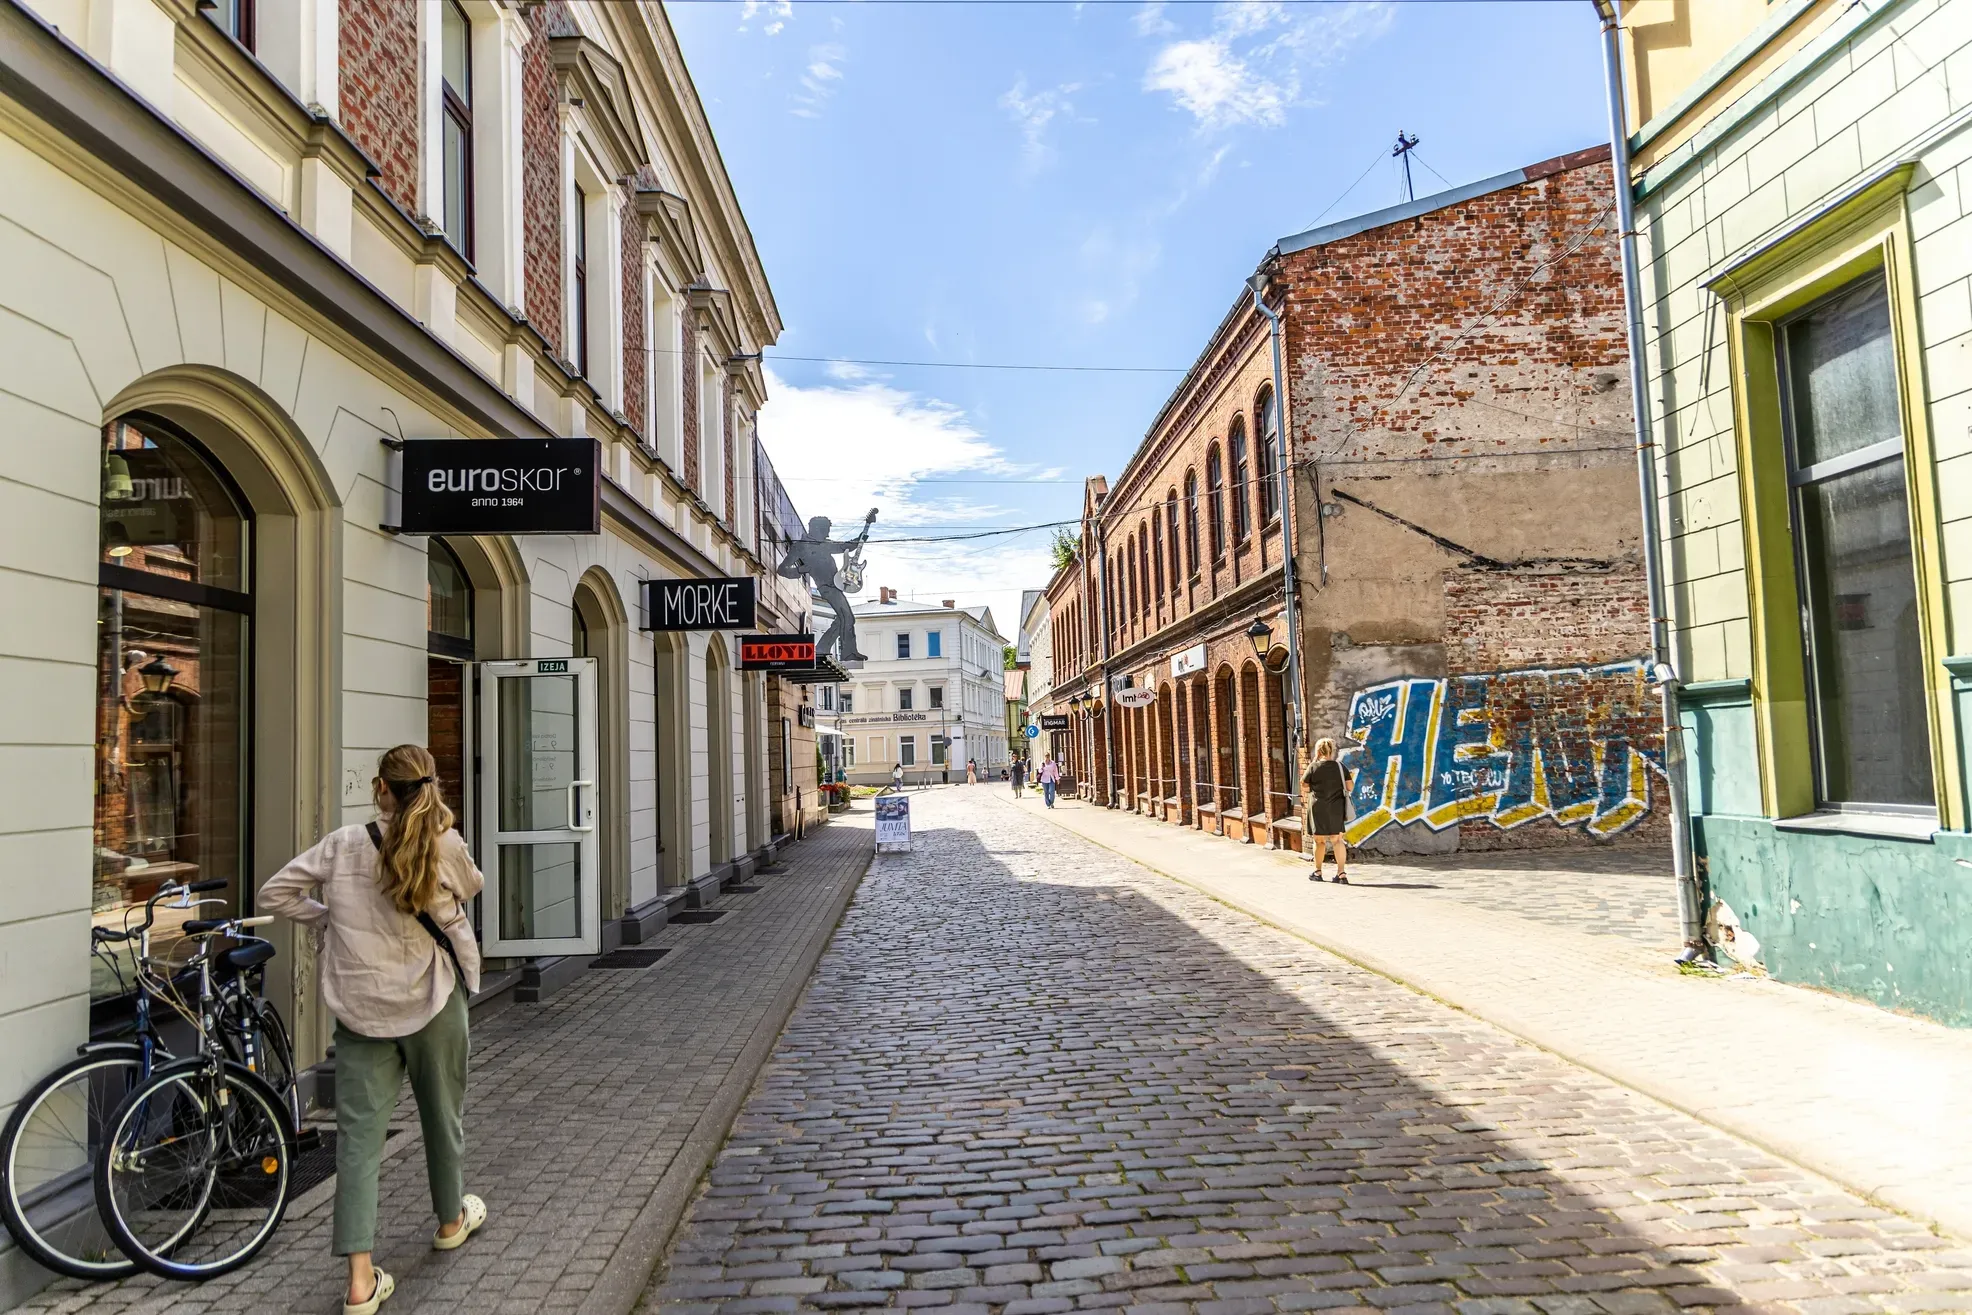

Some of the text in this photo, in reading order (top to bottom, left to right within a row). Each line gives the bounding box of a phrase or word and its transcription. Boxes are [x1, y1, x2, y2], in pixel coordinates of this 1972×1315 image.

[428, 467, 567, 492] euroskor
[471, 497, 524, 507] anno 1964
[664, 583, 739, 626] MORKE
[745, 645, 813, 660] LLOYD
[540, 662, 565, 672] IZEJA
[1122, 693, 1136, 703] lmt
